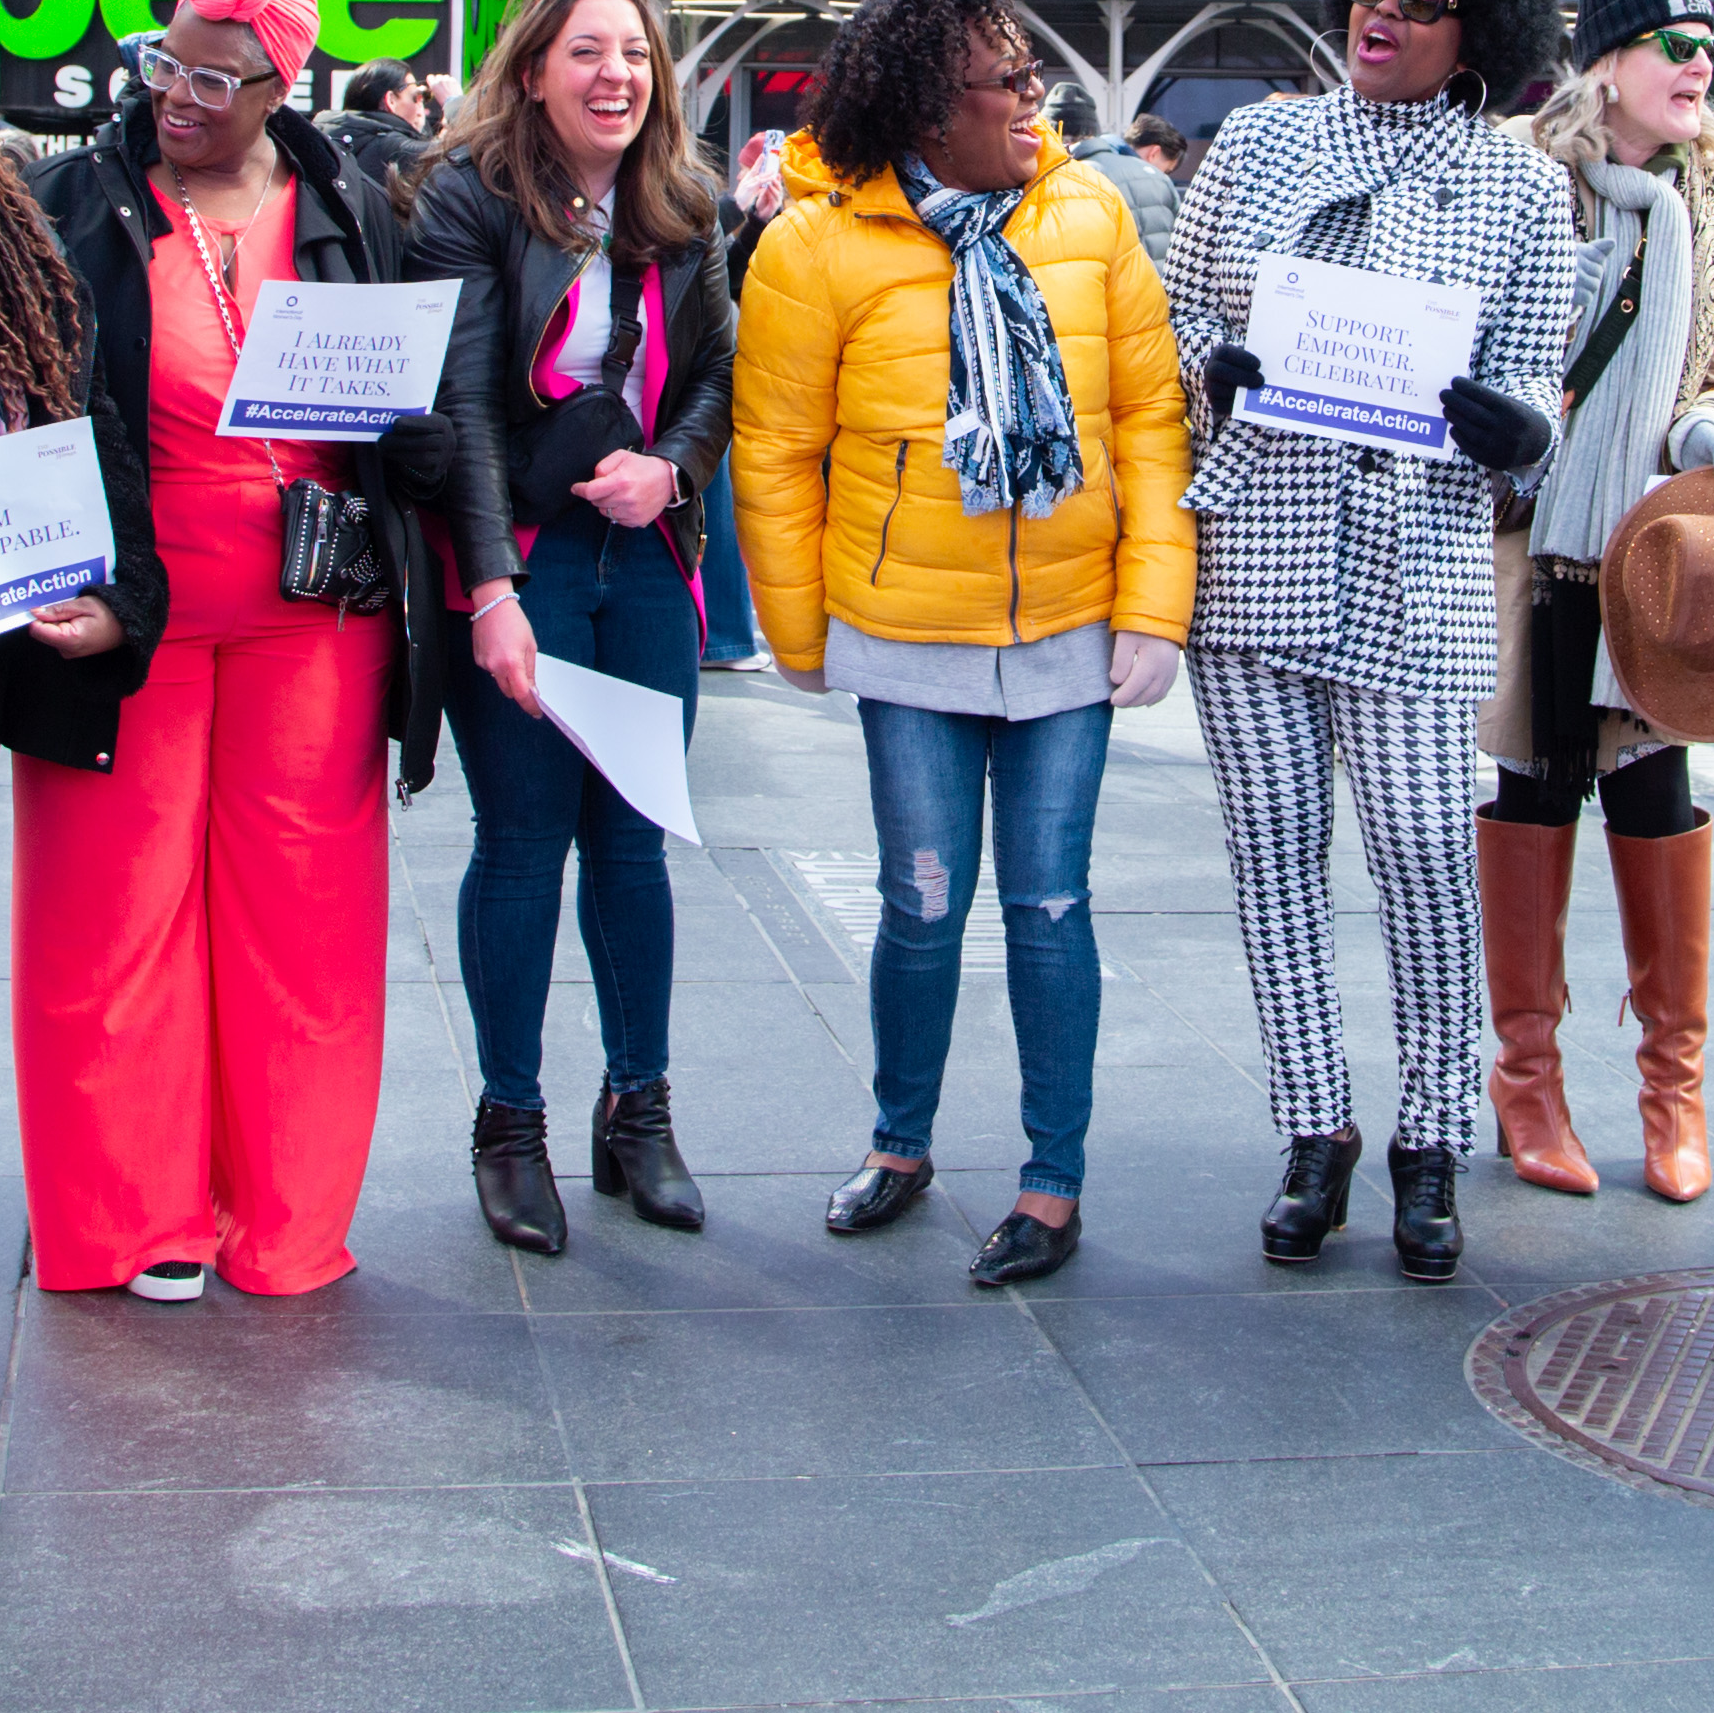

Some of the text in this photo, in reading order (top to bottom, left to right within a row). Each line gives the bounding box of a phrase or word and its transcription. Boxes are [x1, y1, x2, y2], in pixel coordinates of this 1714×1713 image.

[294, 331, 407, 351] I ALREADY
[1305, 309, 1413, 347] SUPPORT.
[277, 352, 410, 374] HAVE WHAT
[1296, 332, 1414, 372] EMPOWER.
[288, 374, 391, 397] IT TAKES.
[1283, 354, 1418, 397] CELEBRATE.
[245, 403, 401, 425] #AccelerateActi
[1258, 387, 1431, 435] #AccelerateAction
